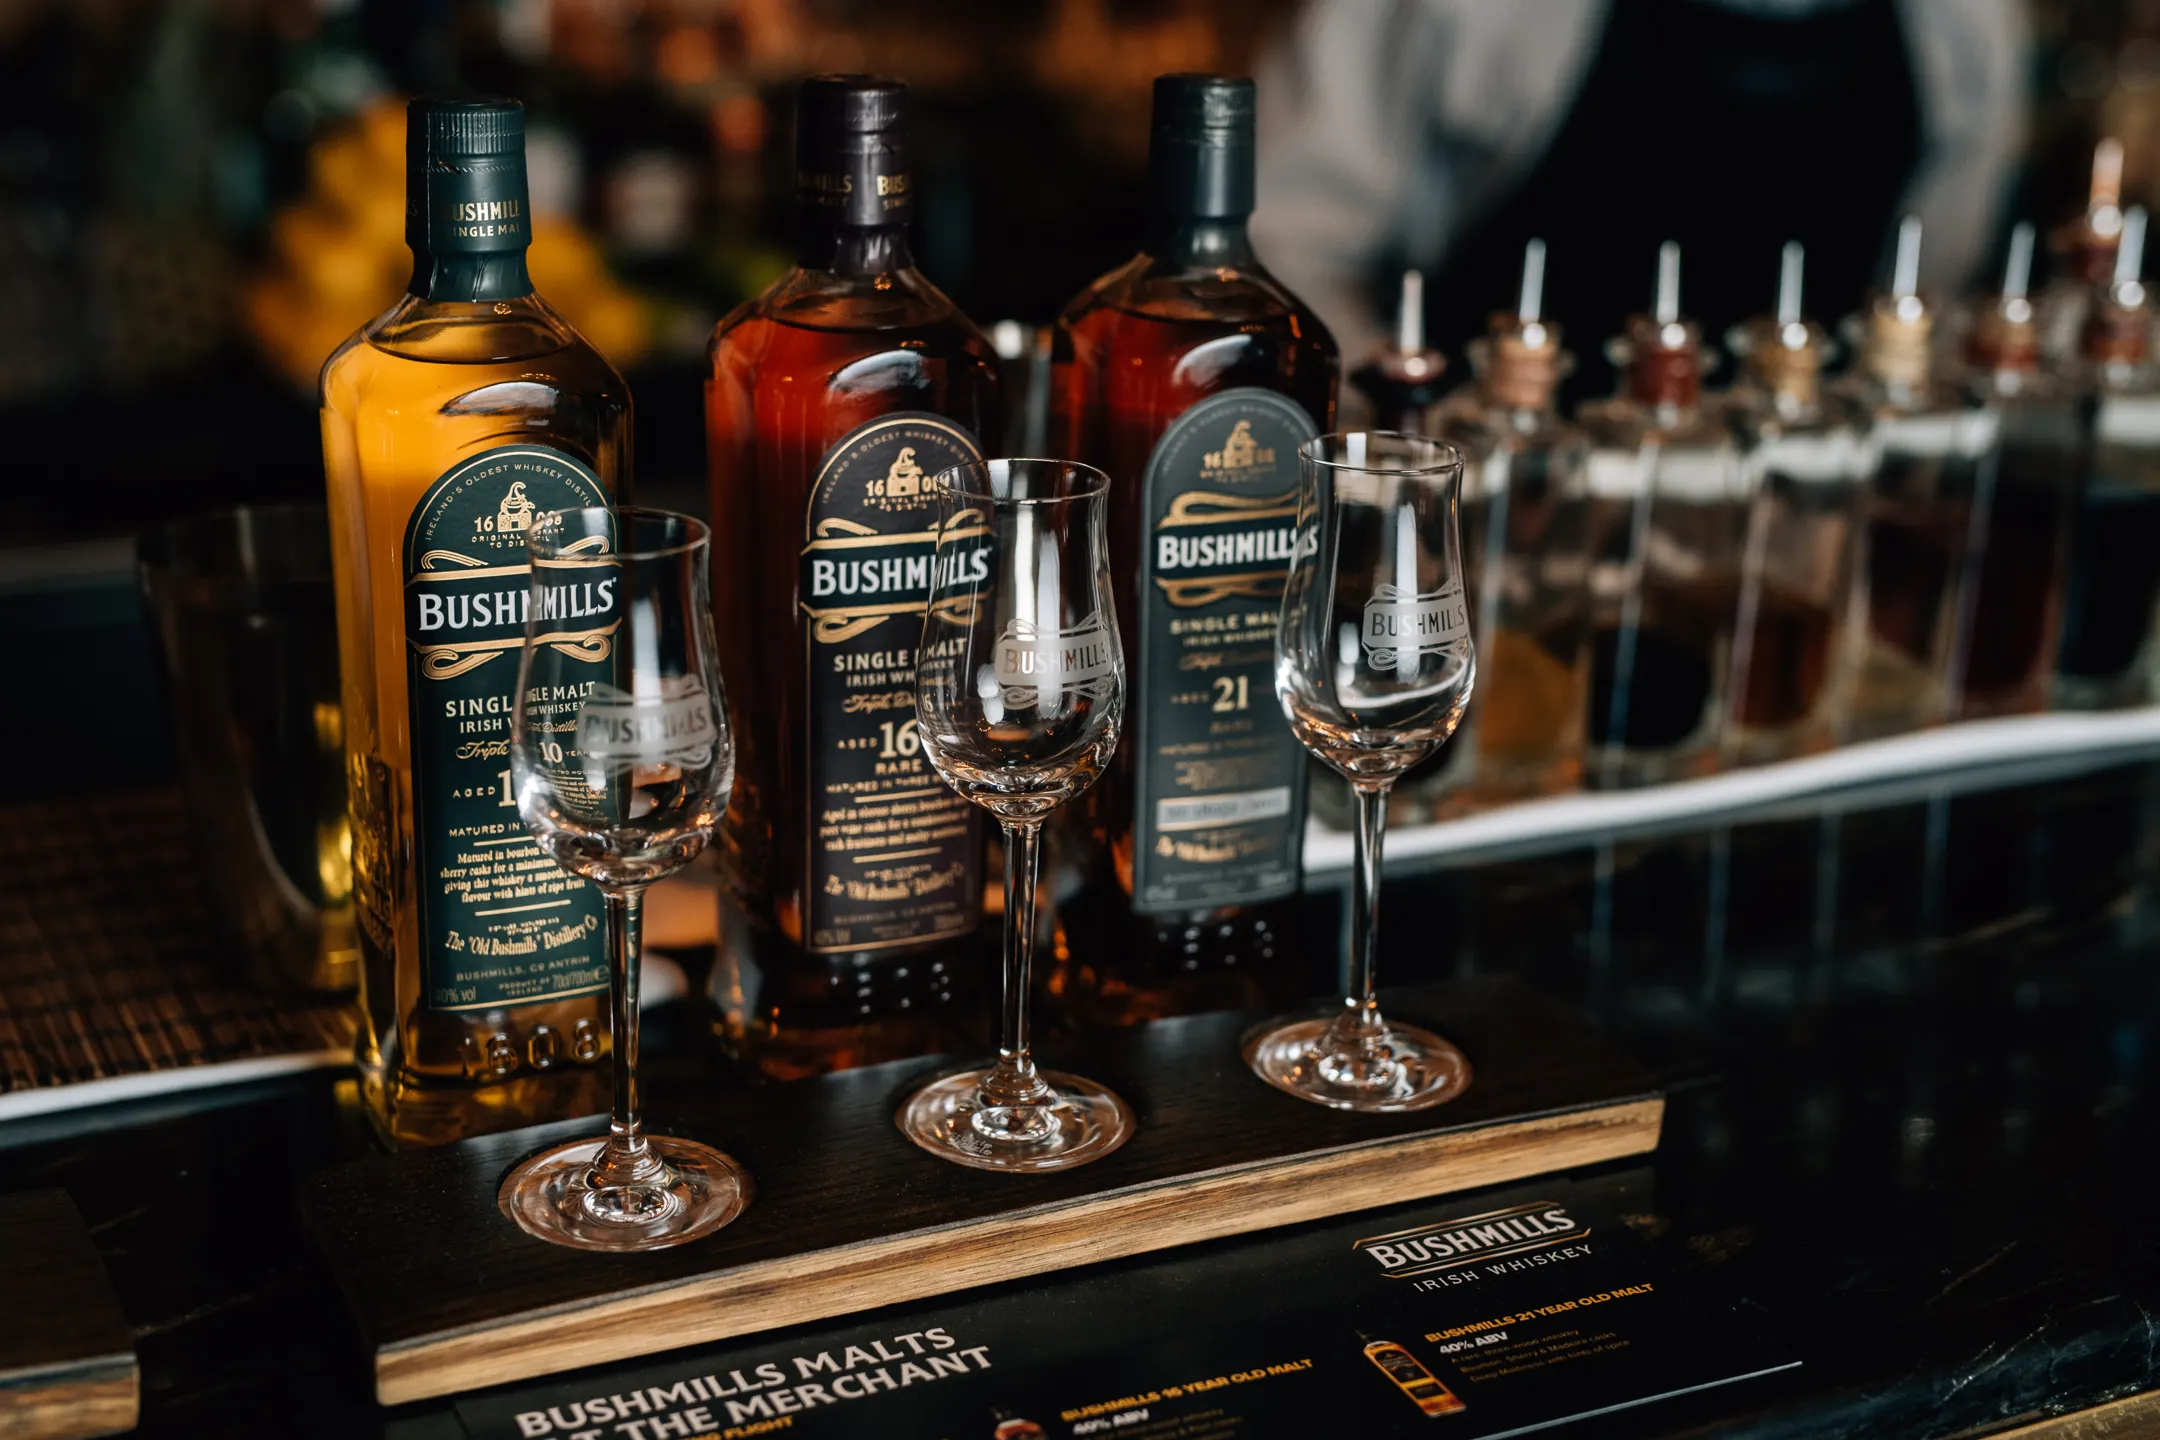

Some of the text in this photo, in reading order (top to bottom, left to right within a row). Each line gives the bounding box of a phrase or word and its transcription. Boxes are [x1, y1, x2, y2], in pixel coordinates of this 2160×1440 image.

[452, 199, 520, 222] USHMILL
[453, 225, 494, 237] INGLE
[865, 479, 885, 497] 16
[424, 463, 592, 540] IRELAND'S OLDEST WHISKEY DISTIL
[473, 516, 494, 533] 16
[471, 533, 522, 544] ORIGINAL
[489, 542, 503, 550] TO
[812, 547, 992, 597] BUSHMILLS
[417, 578, 617, 632] BUSHMILLS
[1371, 604, 1465, 638] BUSHMILLS
[833, 650, 909, 673] SINGLE
[846, 673, 887, 688] IRISH
[445, 695, 513, 718] SINGL
[552, 681, 596, 701] MALT
[1212, 675, 1249, 713] 21
[459, 718, 503, 734] IRISH
[455, 738, 510, 761] Triple
[878, 719, 920, 759] 16
[452, 786, 496, 799] AGED
[448, 823, 505, 837] MATURED
[508, 822, 520, 832] IN
[457, 850, 493, 864] Matured
[495, 849, 504, 861] in
[506, 846, 540, 860] bourbon
[440, 867, 467, 879] sherry
[469, 864, 492, 877] casks
[493, 862, 506, 875] for
[508, 864, 514, 873] a
[444, 880, 471, 894] giving
[473, 877, 490, 889] this
[491, 874, 526, 888] whiskey
[461, 891, 491, 904] flavour
[493, 889, 513, 900] with
[514, 886, 536, 898] hints
[537, 883, 547, 894] of
[543, 923, 587, 950] Distillery
[461, 986, 476, 1002] vol
[1364, 1208, 1576, 1269] BUSHMILLS
[1413, 1244, 1593, 1293] IRISH WHISKEY
[1425, 1283, 1655, 1344] BUSHMILLS 21 YEAR OLD MALT
[1439, 1331, 1509, 1355] 40% ABV
[514, 1327, 956, 1439] BUSHMILLS MALTS
[614, 1345, 993, 1440] THE MERCHANT
[1060, 1390, 1161, 1423] BUSHMILLS
[1182, 1375, 1230, 1395] YEAR
[1230, 1367, 1267, 1384] OLD
[1266, 1358, 1313, 1377] MALT
[723, 1415, 793, 1439] FLIGHT
